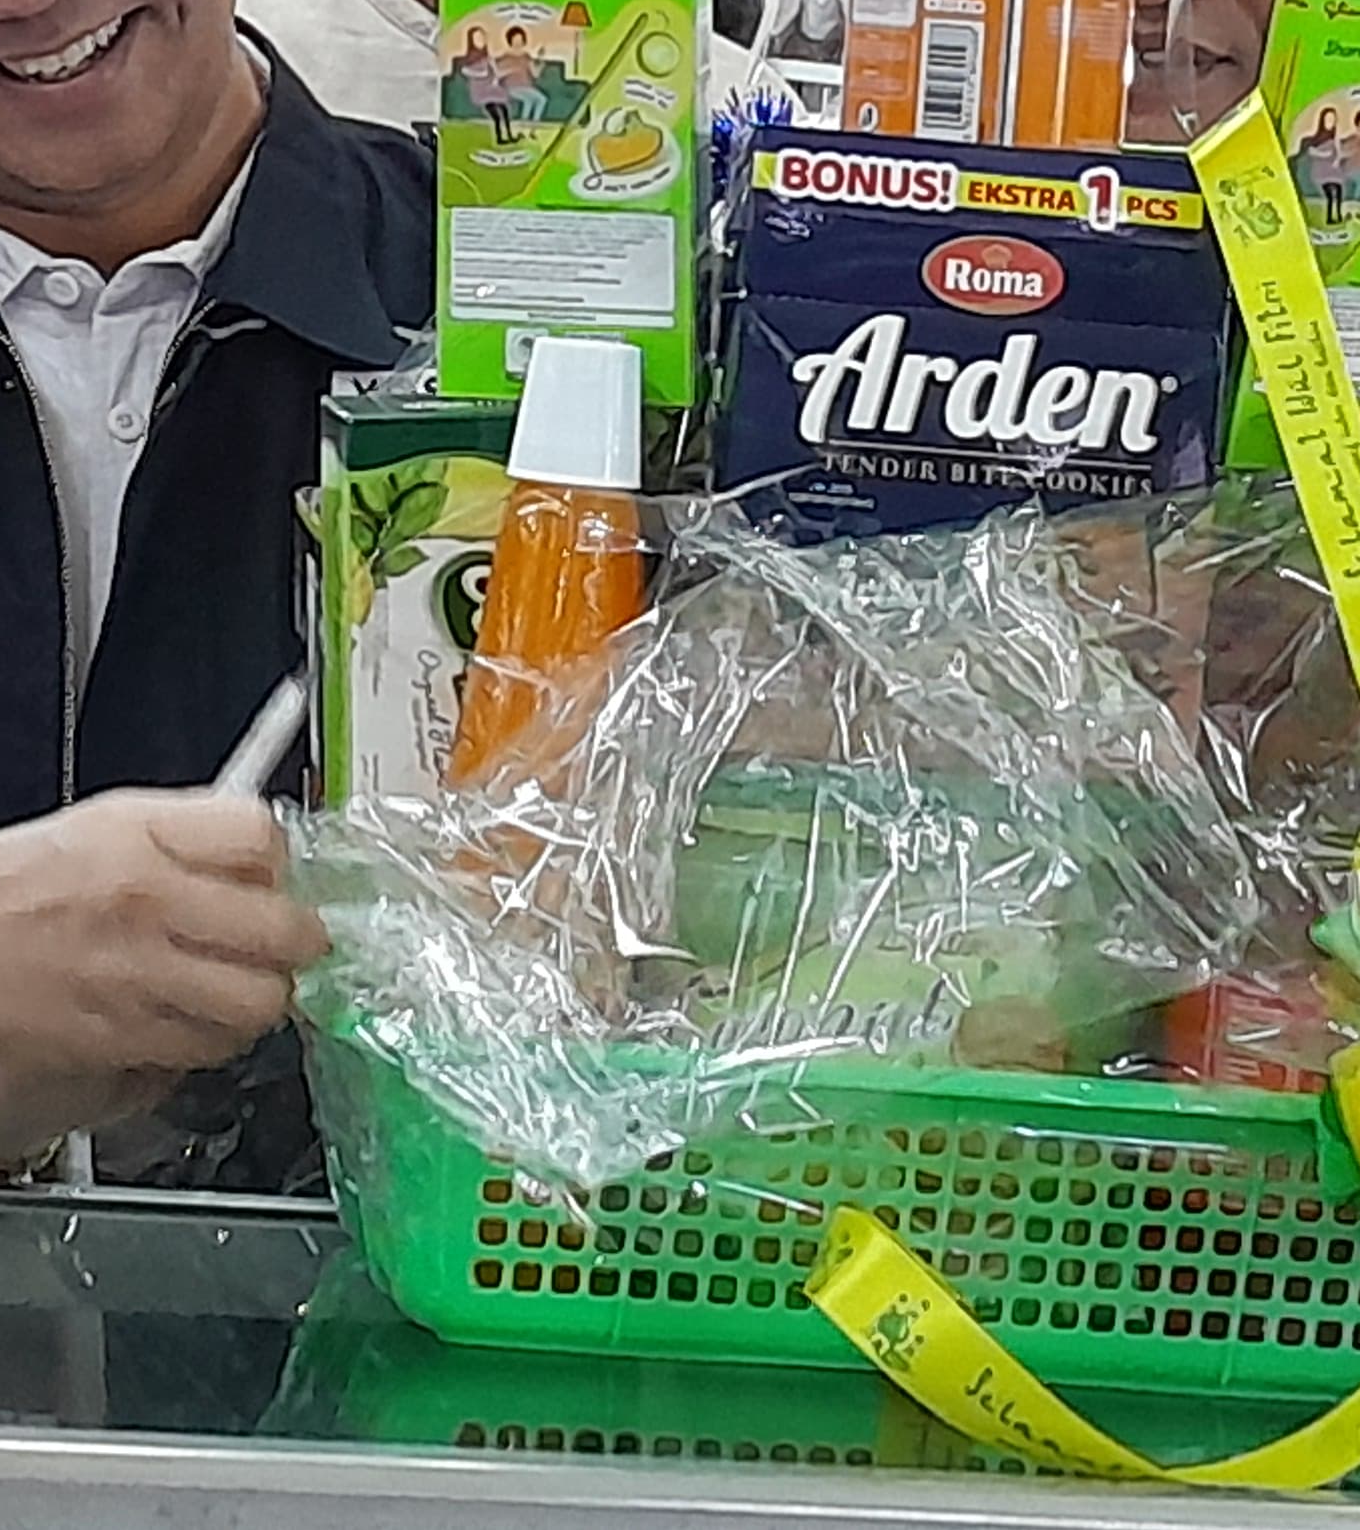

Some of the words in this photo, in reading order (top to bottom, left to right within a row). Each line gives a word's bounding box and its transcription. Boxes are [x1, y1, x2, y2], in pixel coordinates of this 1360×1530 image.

[781, 155, 952, 205] BONUS!
[967, 180, 1076, 213] EKSTRA
[1086, 174, 1114, 223] 1
[1126, 196, 1179, 221] PCS
[944, 257, 1045, 299] Roma
[792, 313, 1159, 453] Arden
[821, 452, 938, 482] TENDER
